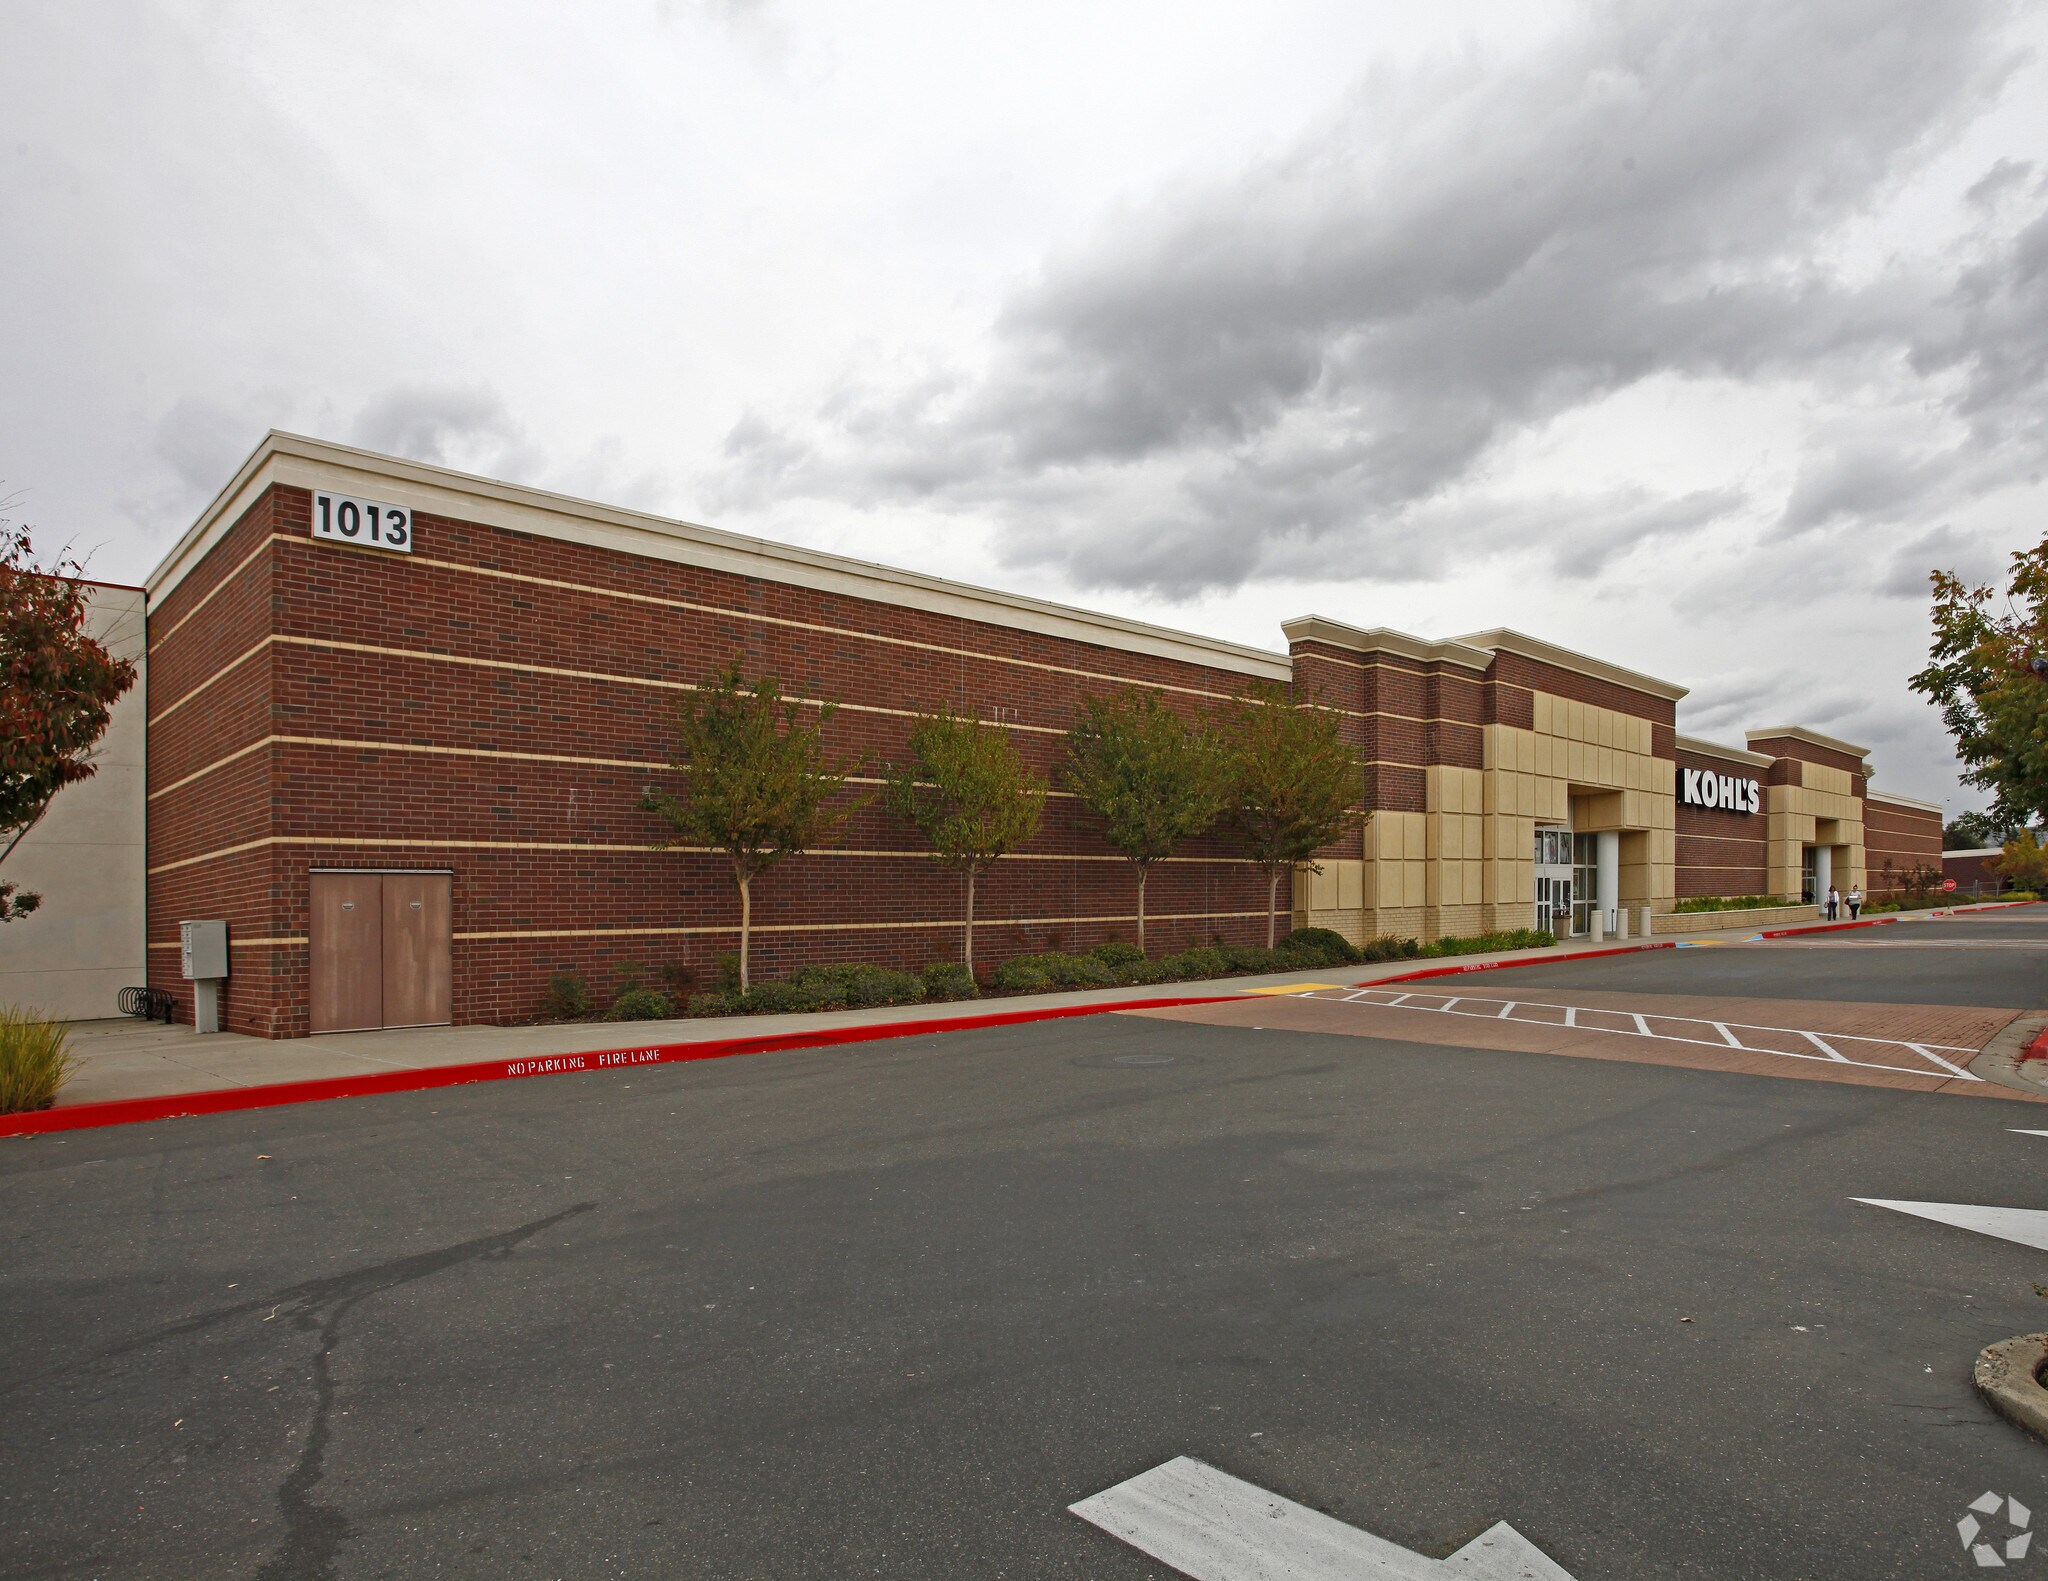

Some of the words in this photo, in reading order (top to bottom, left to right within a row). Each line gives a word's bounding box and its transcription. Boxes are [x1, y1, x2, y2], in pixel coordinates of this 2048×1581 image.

[318, 496, 407, 545] 1013
[1683, 768, 1760, 814] KOHL'S
[507, 1062, 525, 1076] NO
[528, 1056, 585, 1073] PARKING
[599, 1052, 627, 1066] FIRE
[631, 1049, 660, 1063] LANE
